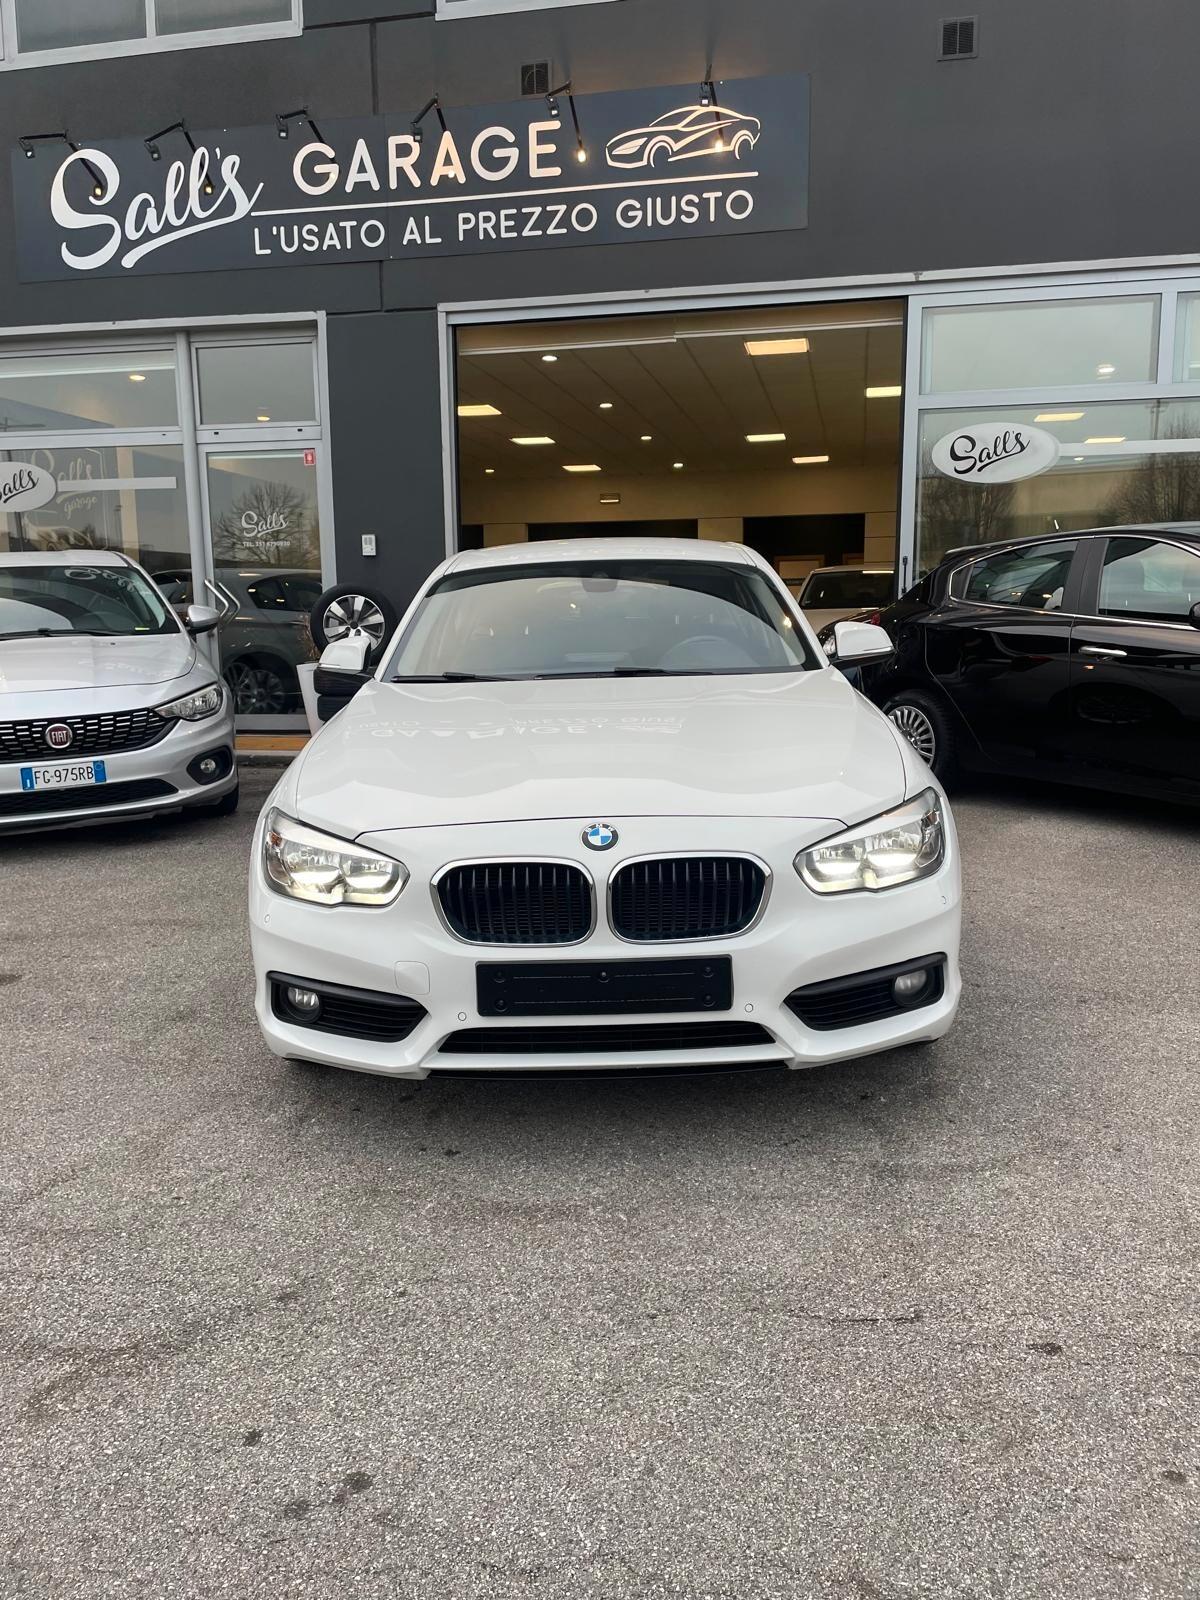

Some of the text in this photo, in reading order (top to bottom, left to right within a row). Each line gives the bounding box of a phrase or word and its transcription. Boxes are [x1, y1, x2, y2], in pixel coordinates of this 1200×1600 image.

[51, 120, 562, 270] Sall's GARAGE
[255, 189, 754, 254] L'USATO AL PREZZO GIUSTO
[950, 430, 1031, 475] Sall's
[52, 731, 67, 743] FIAT
